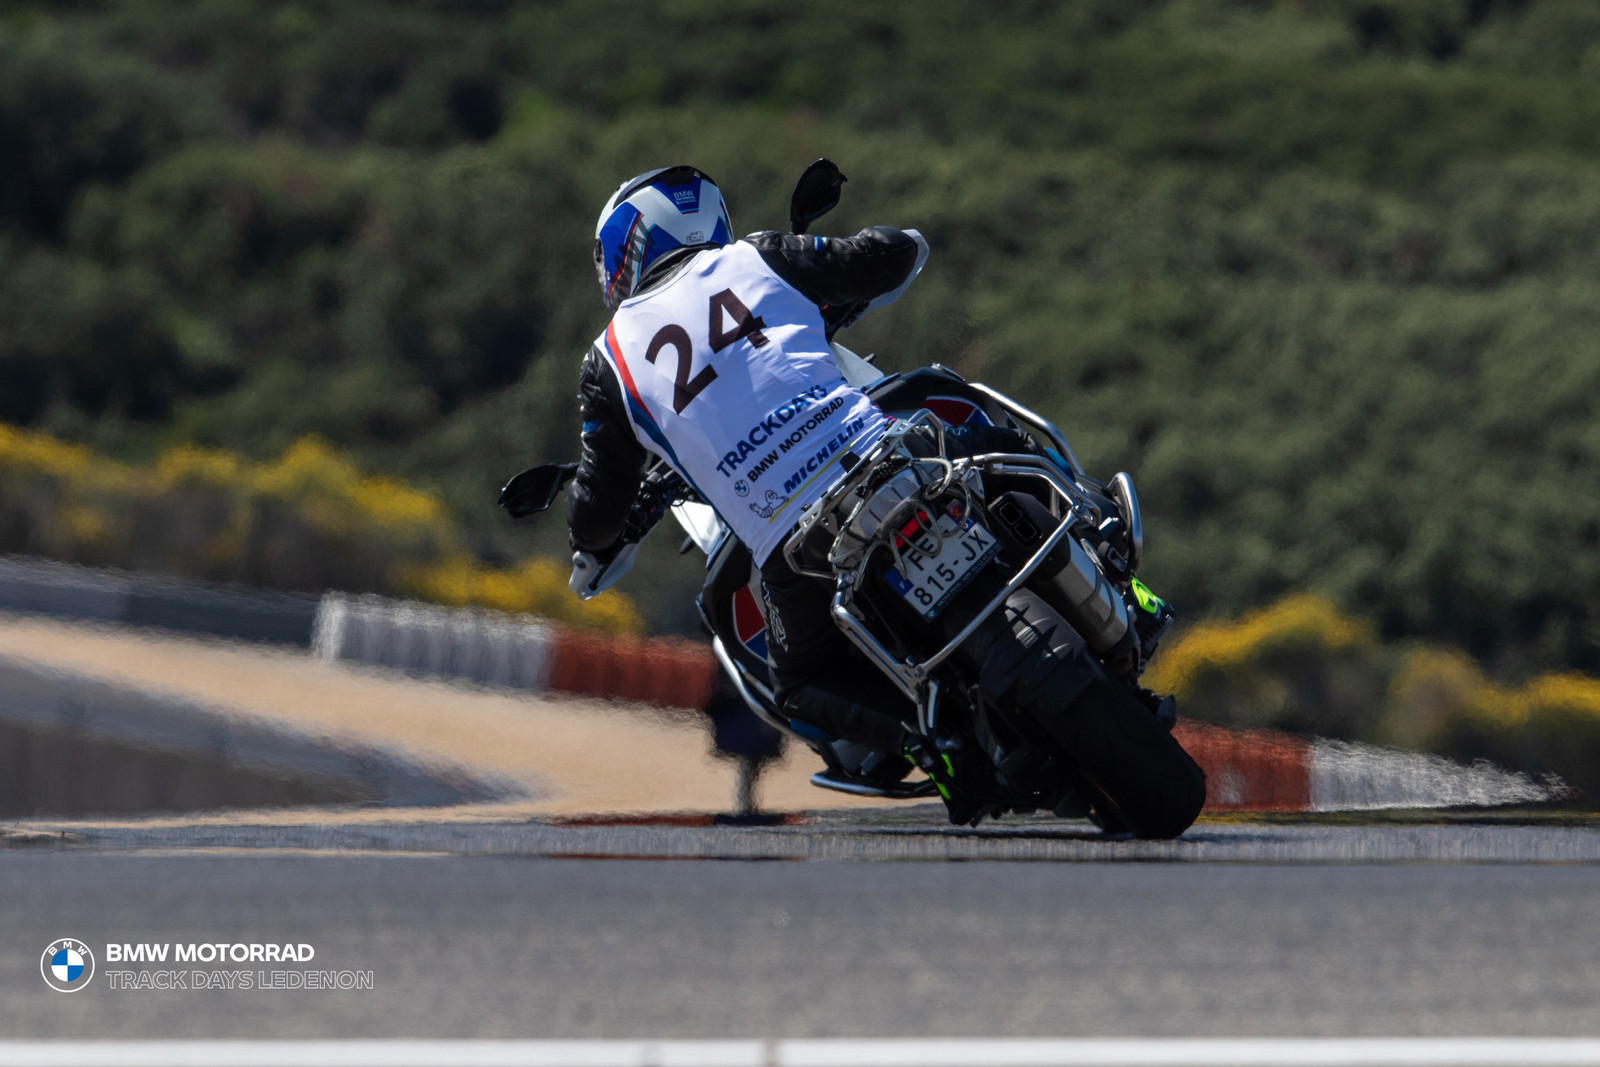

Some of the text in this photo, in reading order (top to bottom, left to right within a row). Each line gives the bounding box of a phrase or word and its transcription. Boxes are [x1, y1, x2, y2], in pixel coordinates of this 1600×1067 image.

[673, 190, 693, 199] BMW
[645, 288, 770, 415] 24
[747, 396, 845, 482] BMW MOTORRAD
[783, 417, 864, 494] MICHELIN
